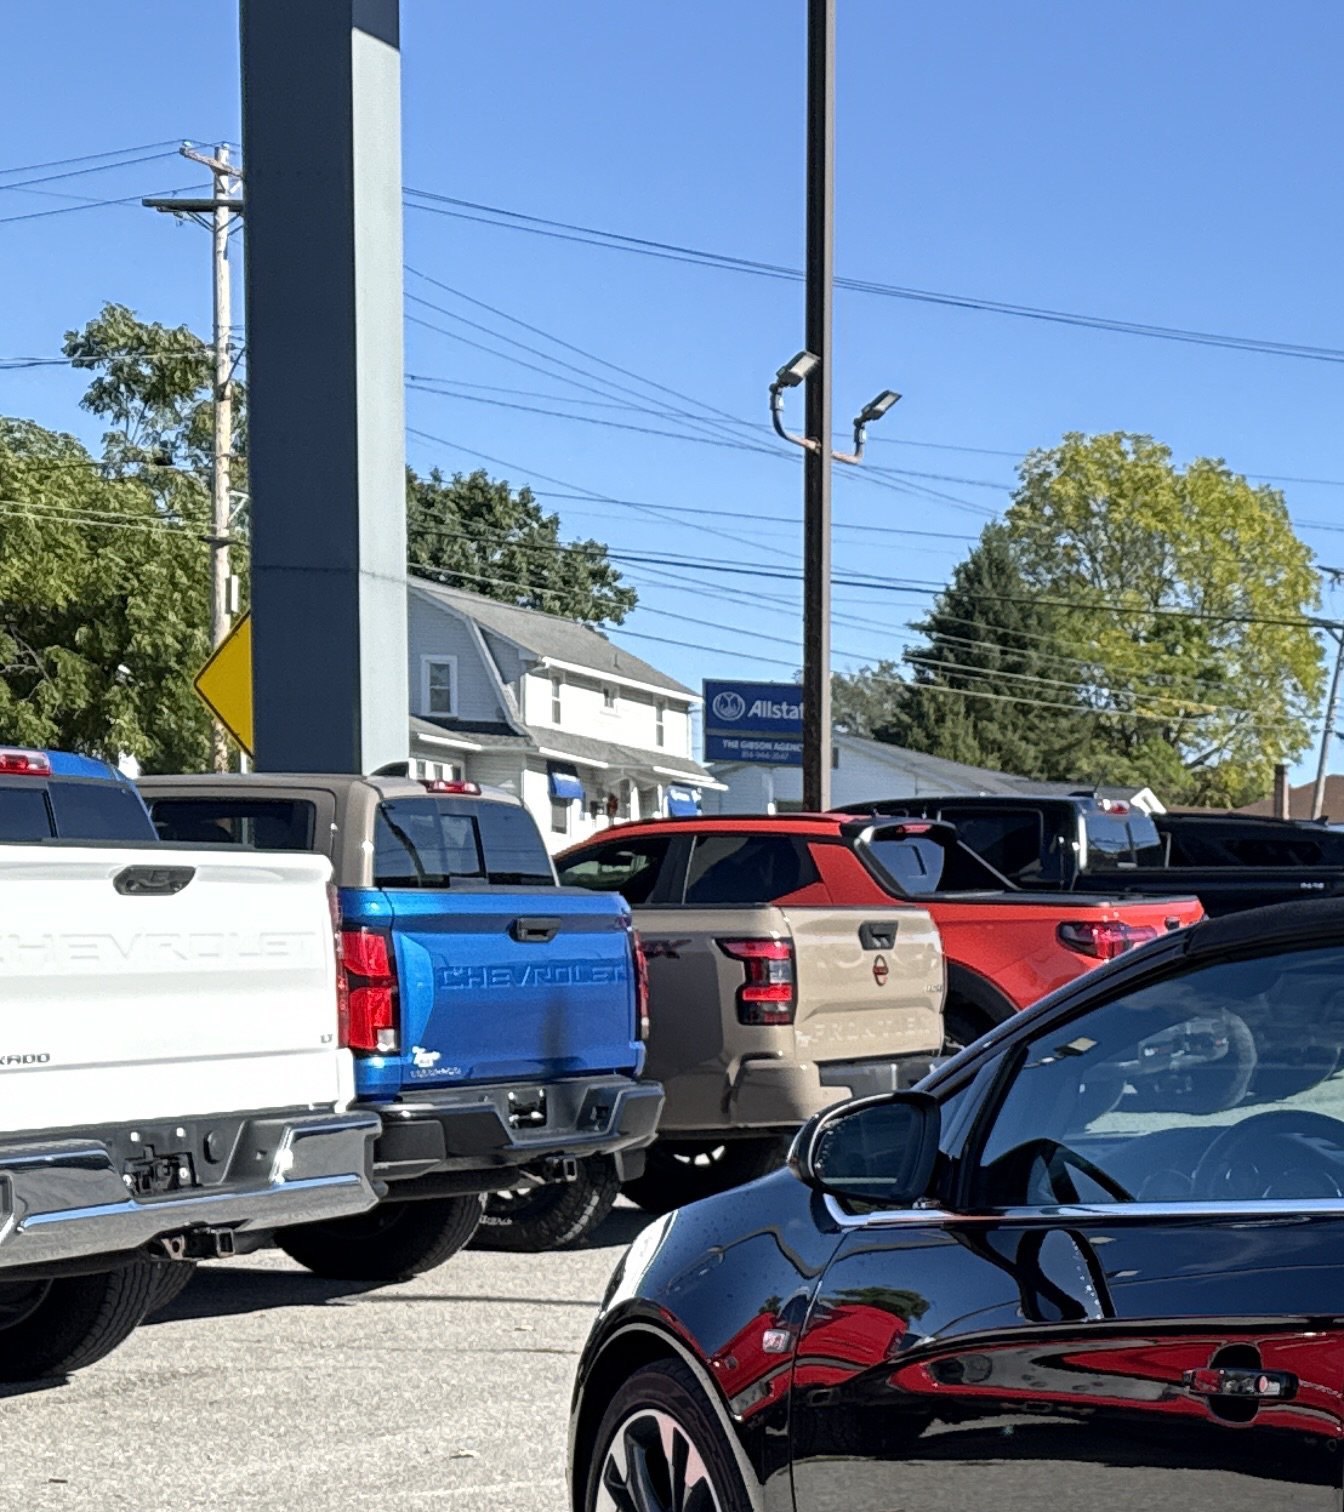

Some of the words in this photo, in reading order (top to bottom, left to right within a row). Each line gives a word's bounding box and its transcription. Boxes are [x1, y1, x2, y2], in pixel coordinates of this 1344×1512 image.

[747, 700, 804, 719] Allstat
[773, 741, 804, 752] AGENC
[0, 932, 318, 960] HEVROLET
[438, 962, 628, 990] CHEVROLET
